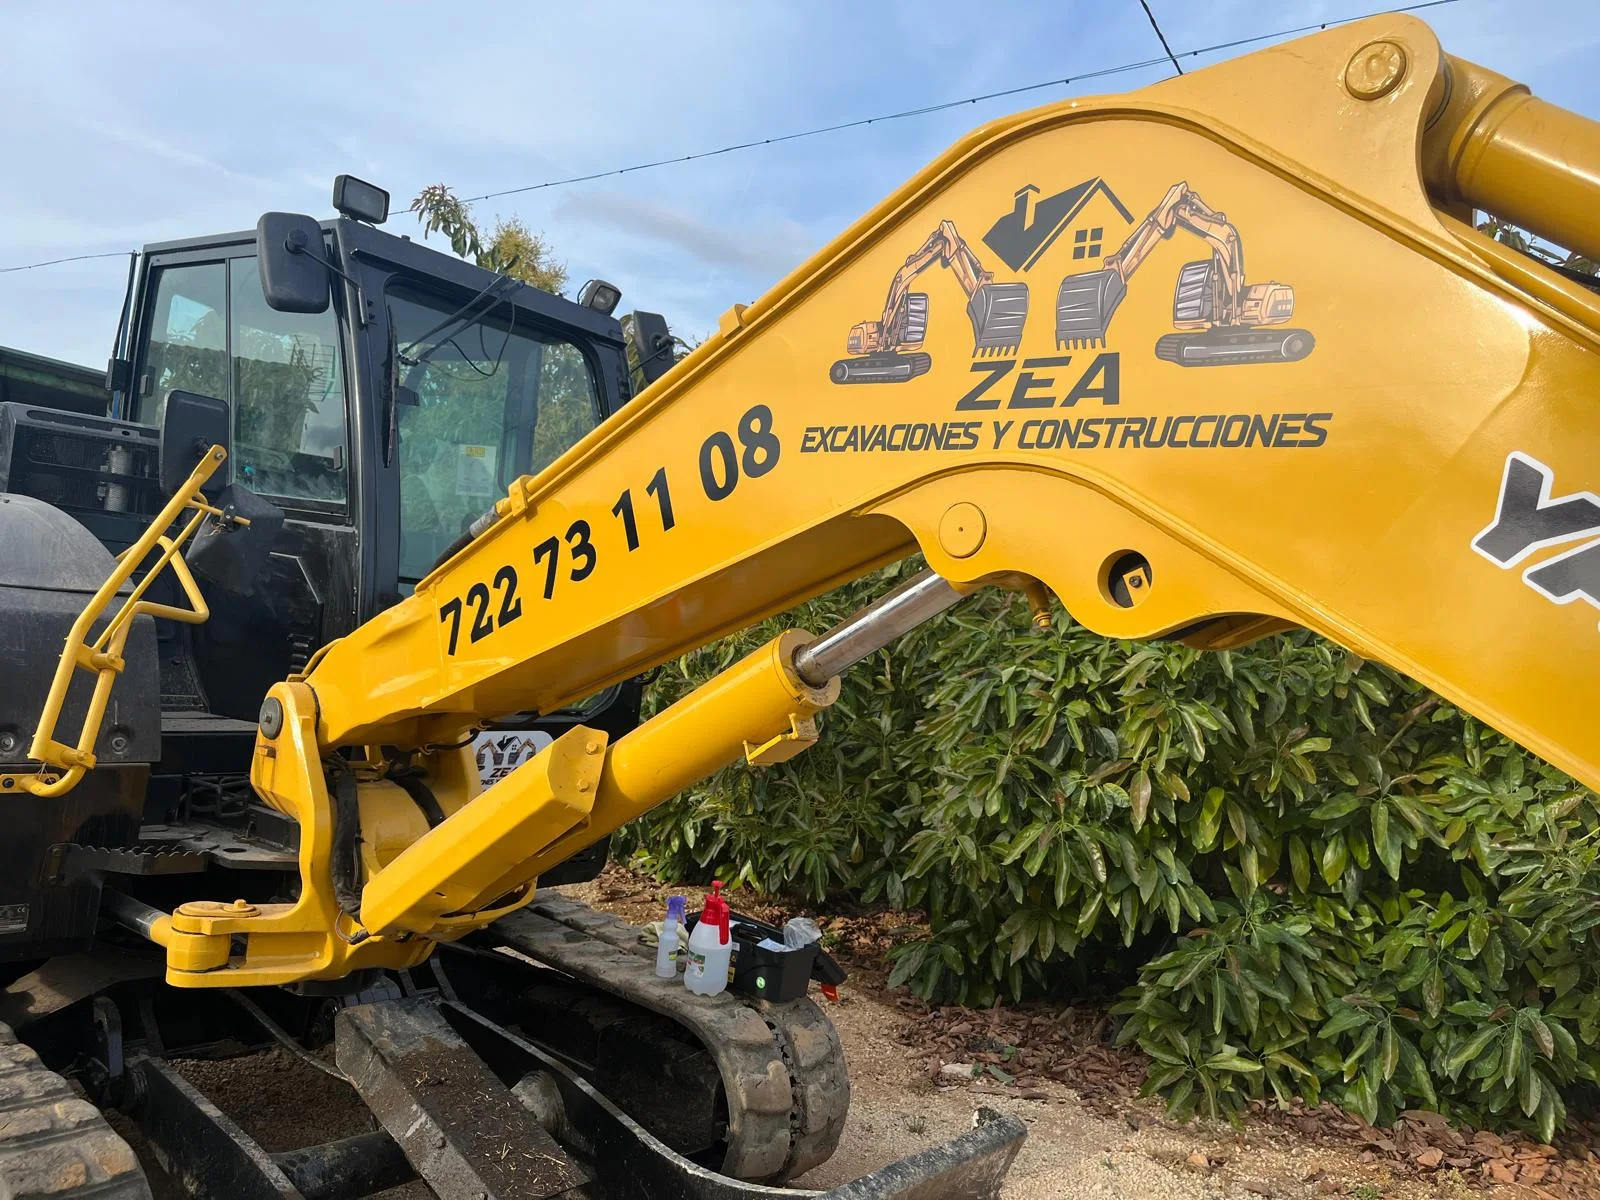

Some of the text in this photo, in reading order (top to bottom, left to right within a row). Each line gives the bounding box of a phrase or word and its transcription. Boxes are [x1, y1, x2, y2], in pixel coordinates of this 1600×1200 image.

[955, 352, 1120, 411] ZEA
[800, 412, 1333, 453] EXCAVACIONES Y CONSTRUCCIONES
[439, 404, 781, 656] 722 73 11 08
[489, 767, 518, 778] ZE
